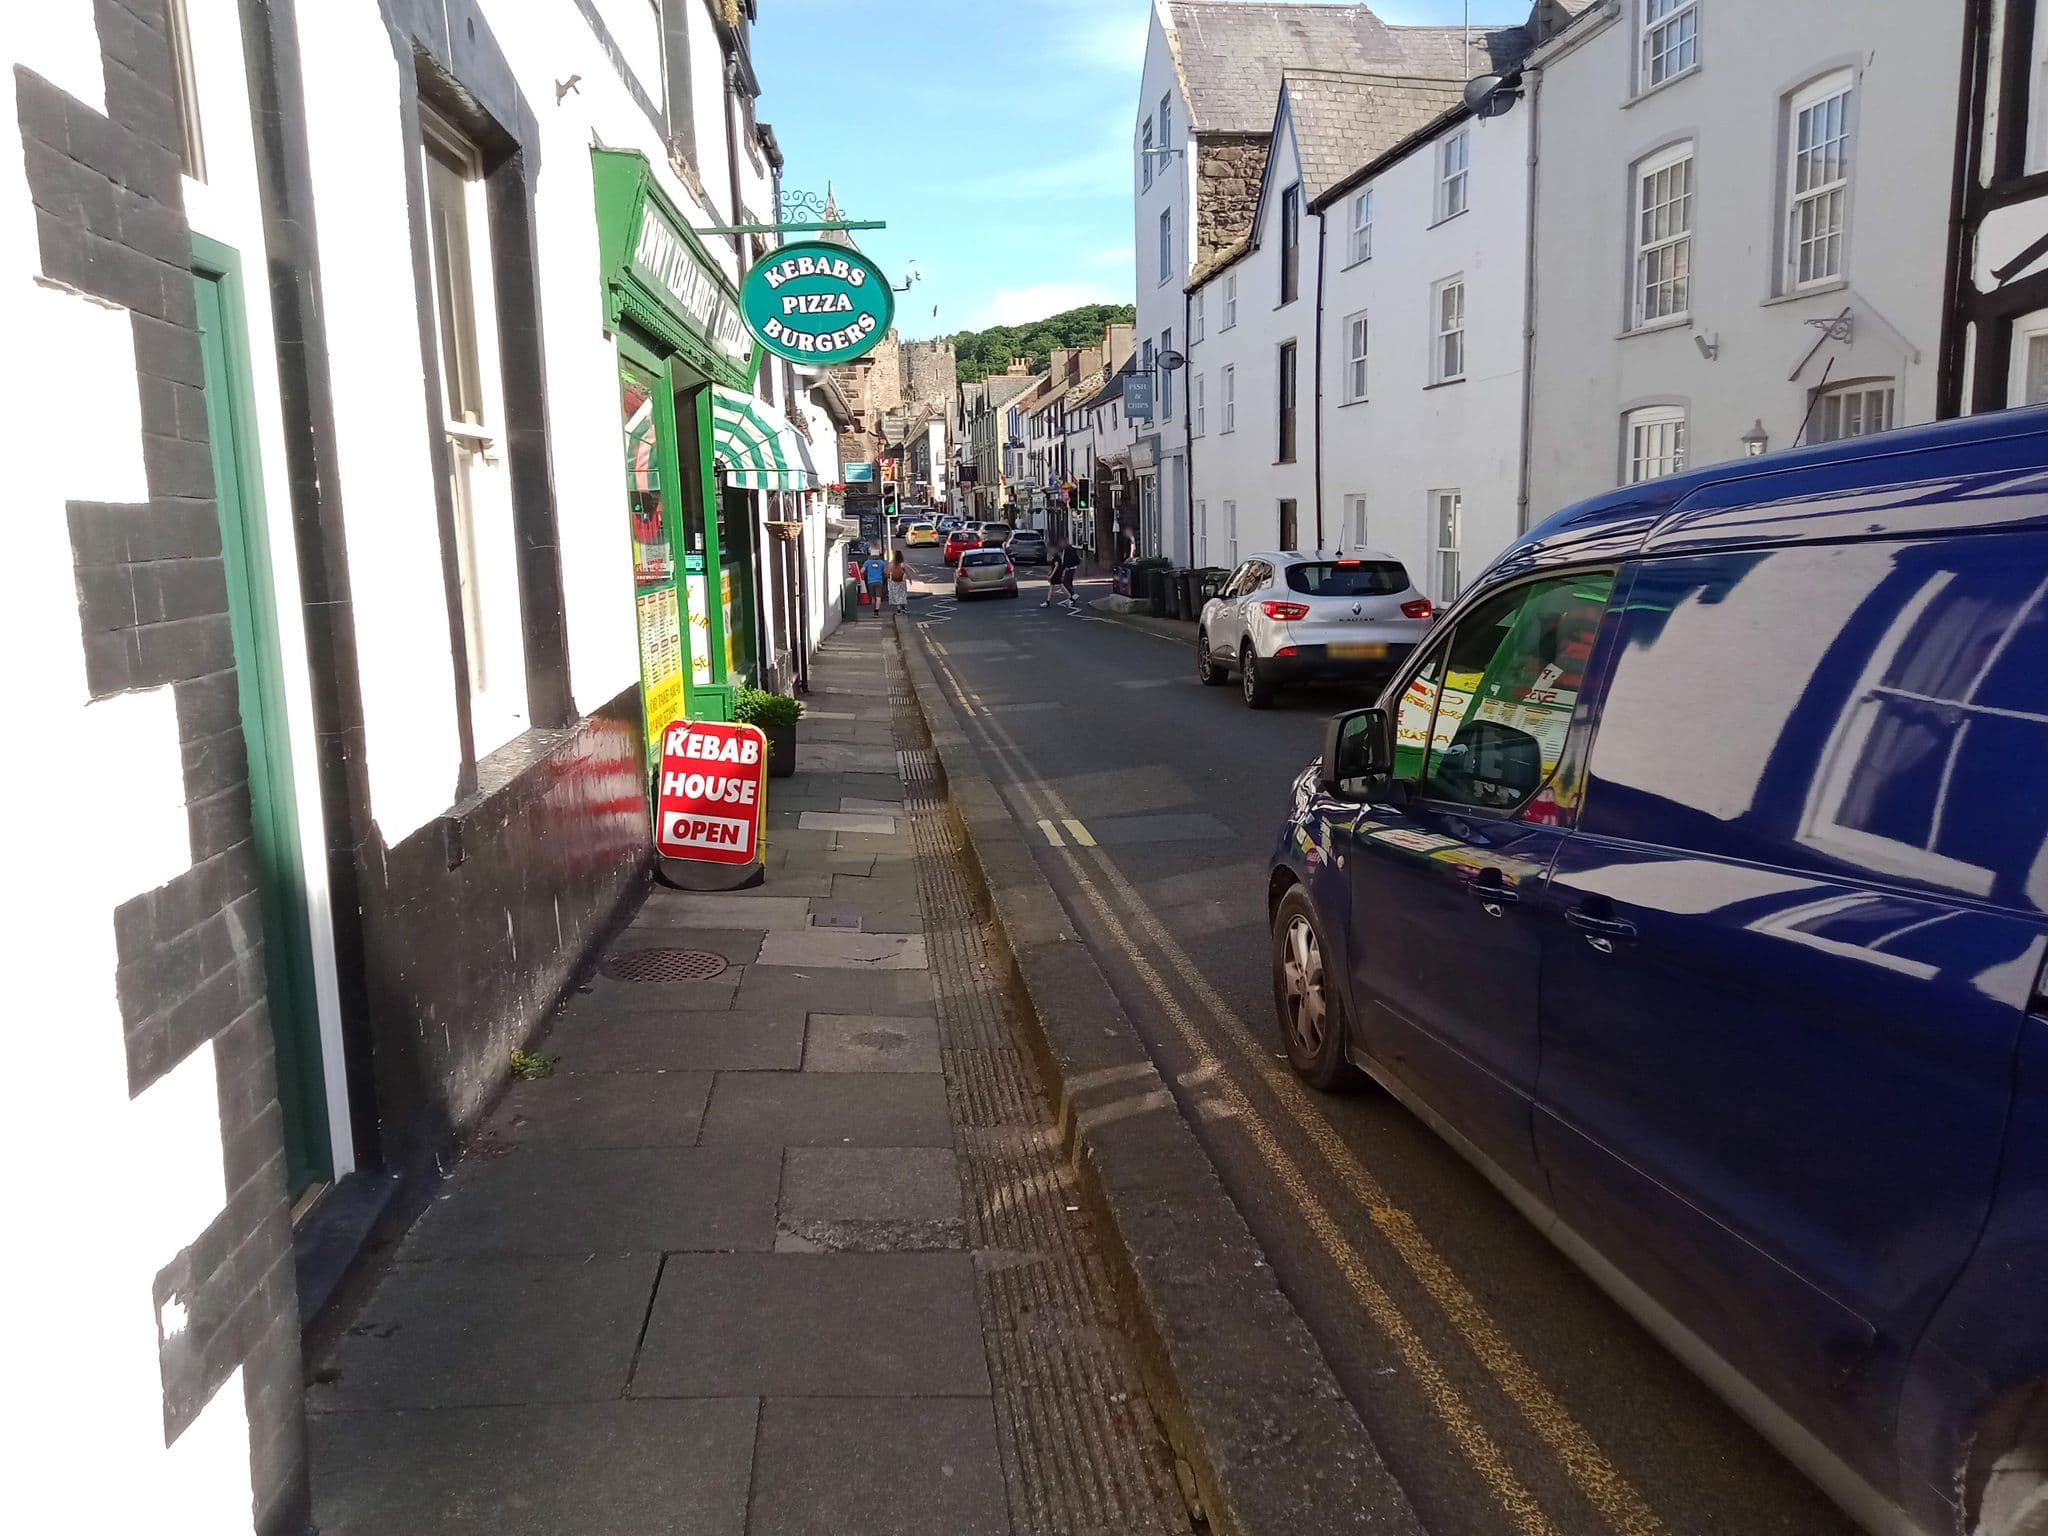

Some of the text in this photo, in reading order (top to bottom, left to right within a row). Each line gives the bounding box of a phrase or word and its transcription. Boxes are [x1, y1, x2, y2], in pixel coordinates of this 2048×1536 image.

[763, 256, 866, 289] KEBABS
[781, 292, 854, 315] PIZZA
[762, 313, 877, 352] BURGERS
[665, 727, 759, 765] KEBAB
[663, 771, 757, 805] HOUSE
[672, 819, 740, 845] OPEN
